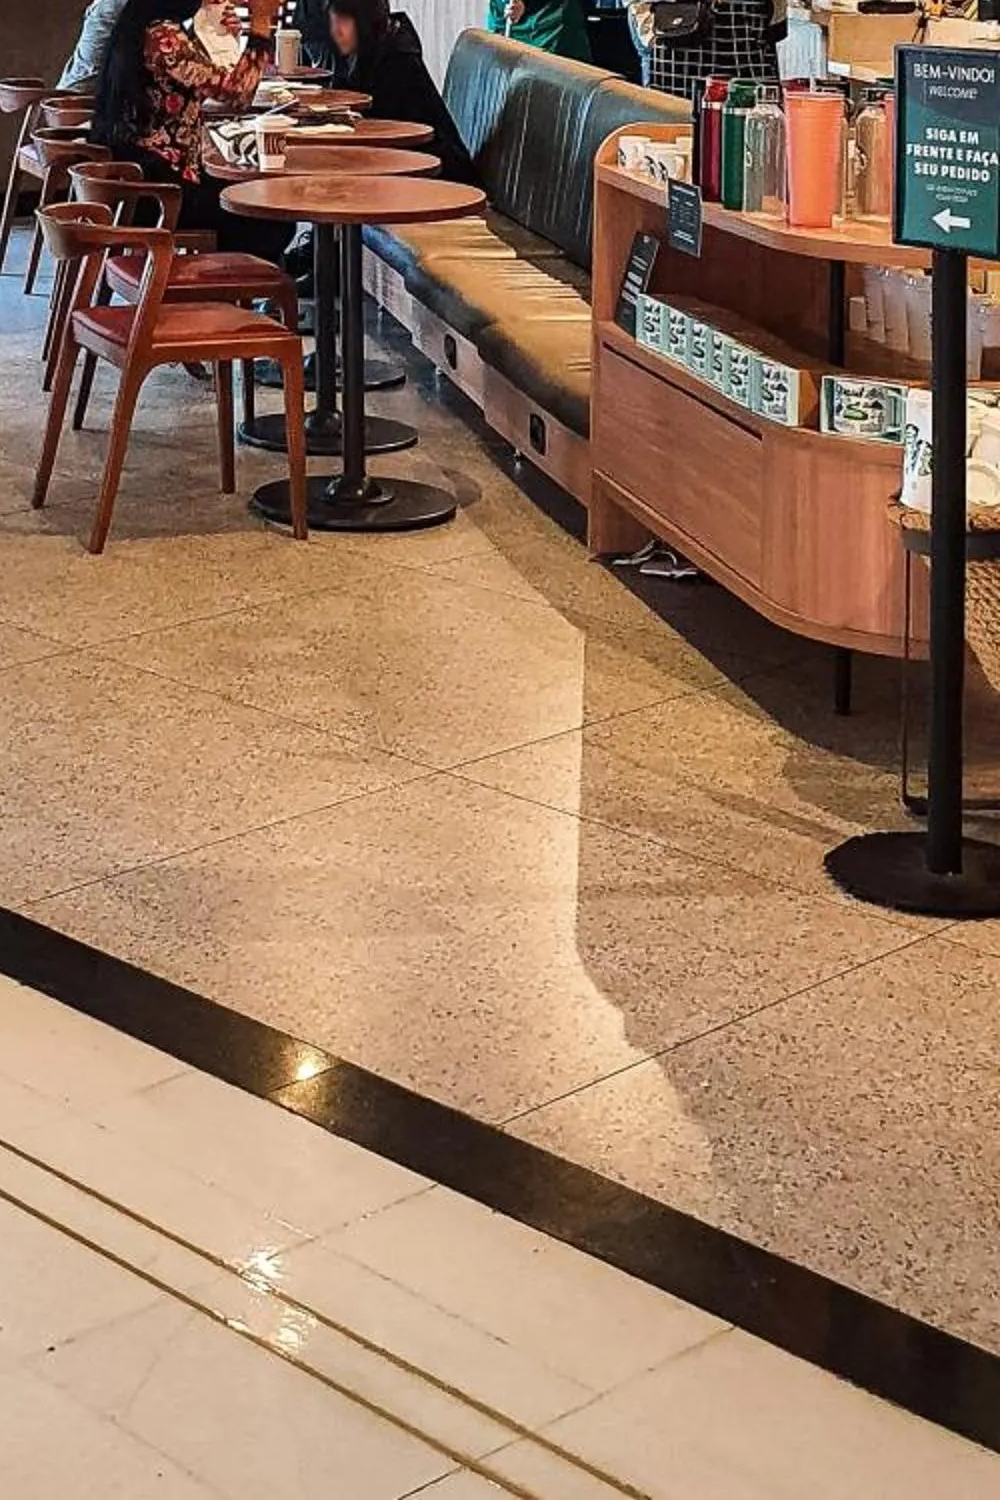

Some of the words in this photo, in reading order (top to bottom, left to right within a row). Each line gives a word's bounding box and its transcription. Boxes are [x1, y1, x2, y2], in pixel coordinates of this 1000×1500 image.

[913, 63, 995, 83] BEM-VINDO!
[925, 127, 957, 142] SIGA
[960, 131, 980, 145] EM
[906, 143, 954, 160] FRENTE
[956, 148, 964, 161] E
[966, 150, 999, 168] FAÇA
[914, 161, 938, 176] SEU
[941, 165, 991, 182] PEDIDO
